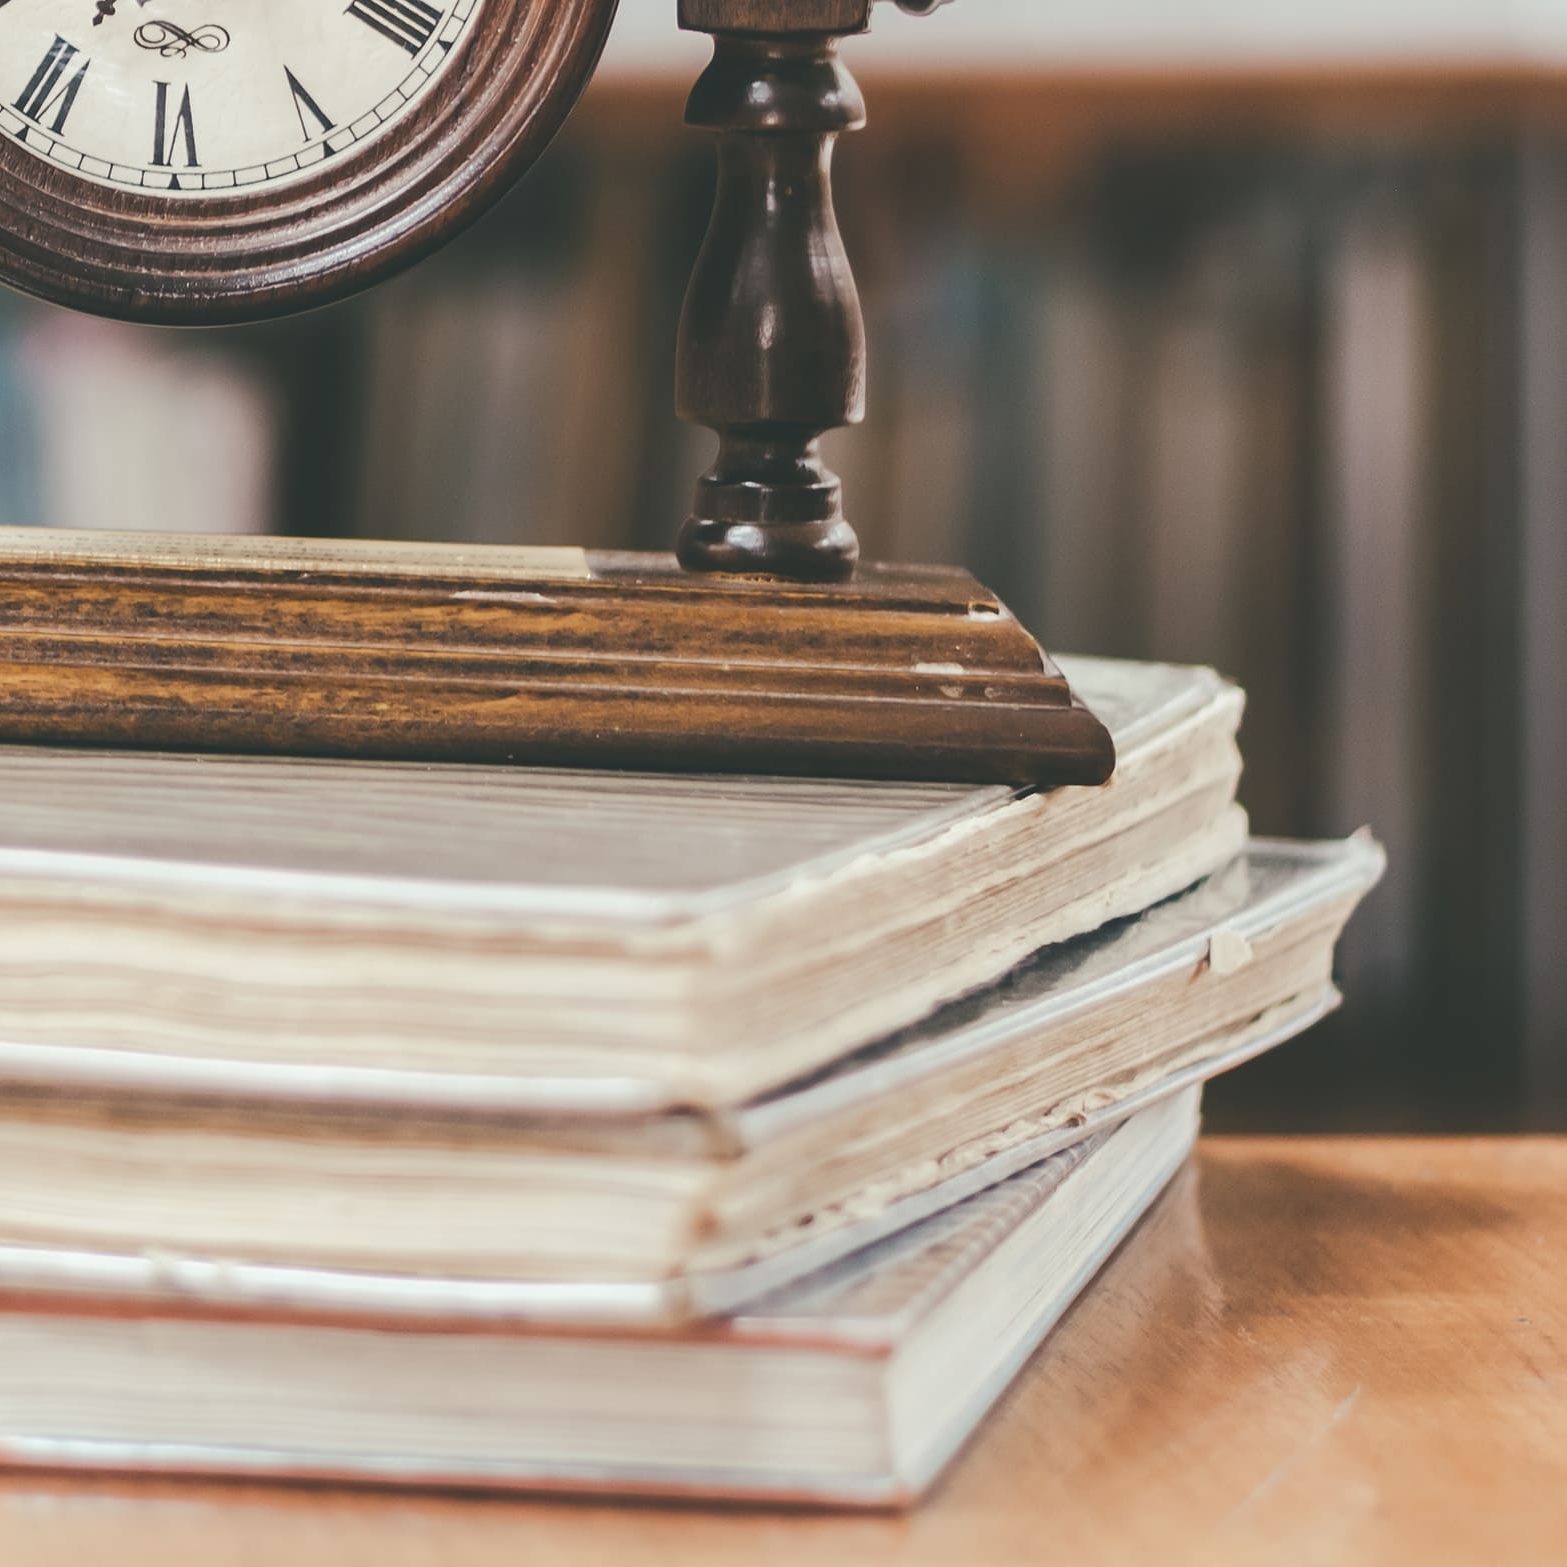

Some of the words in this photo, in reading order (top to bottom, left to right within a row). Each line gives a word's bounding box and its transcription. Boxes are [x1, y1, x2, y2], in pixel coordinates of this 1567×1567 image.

[11, 34, 90, 136] VII
[148, 81, 202, 168] VI
[283, 65, 337, 142] V
